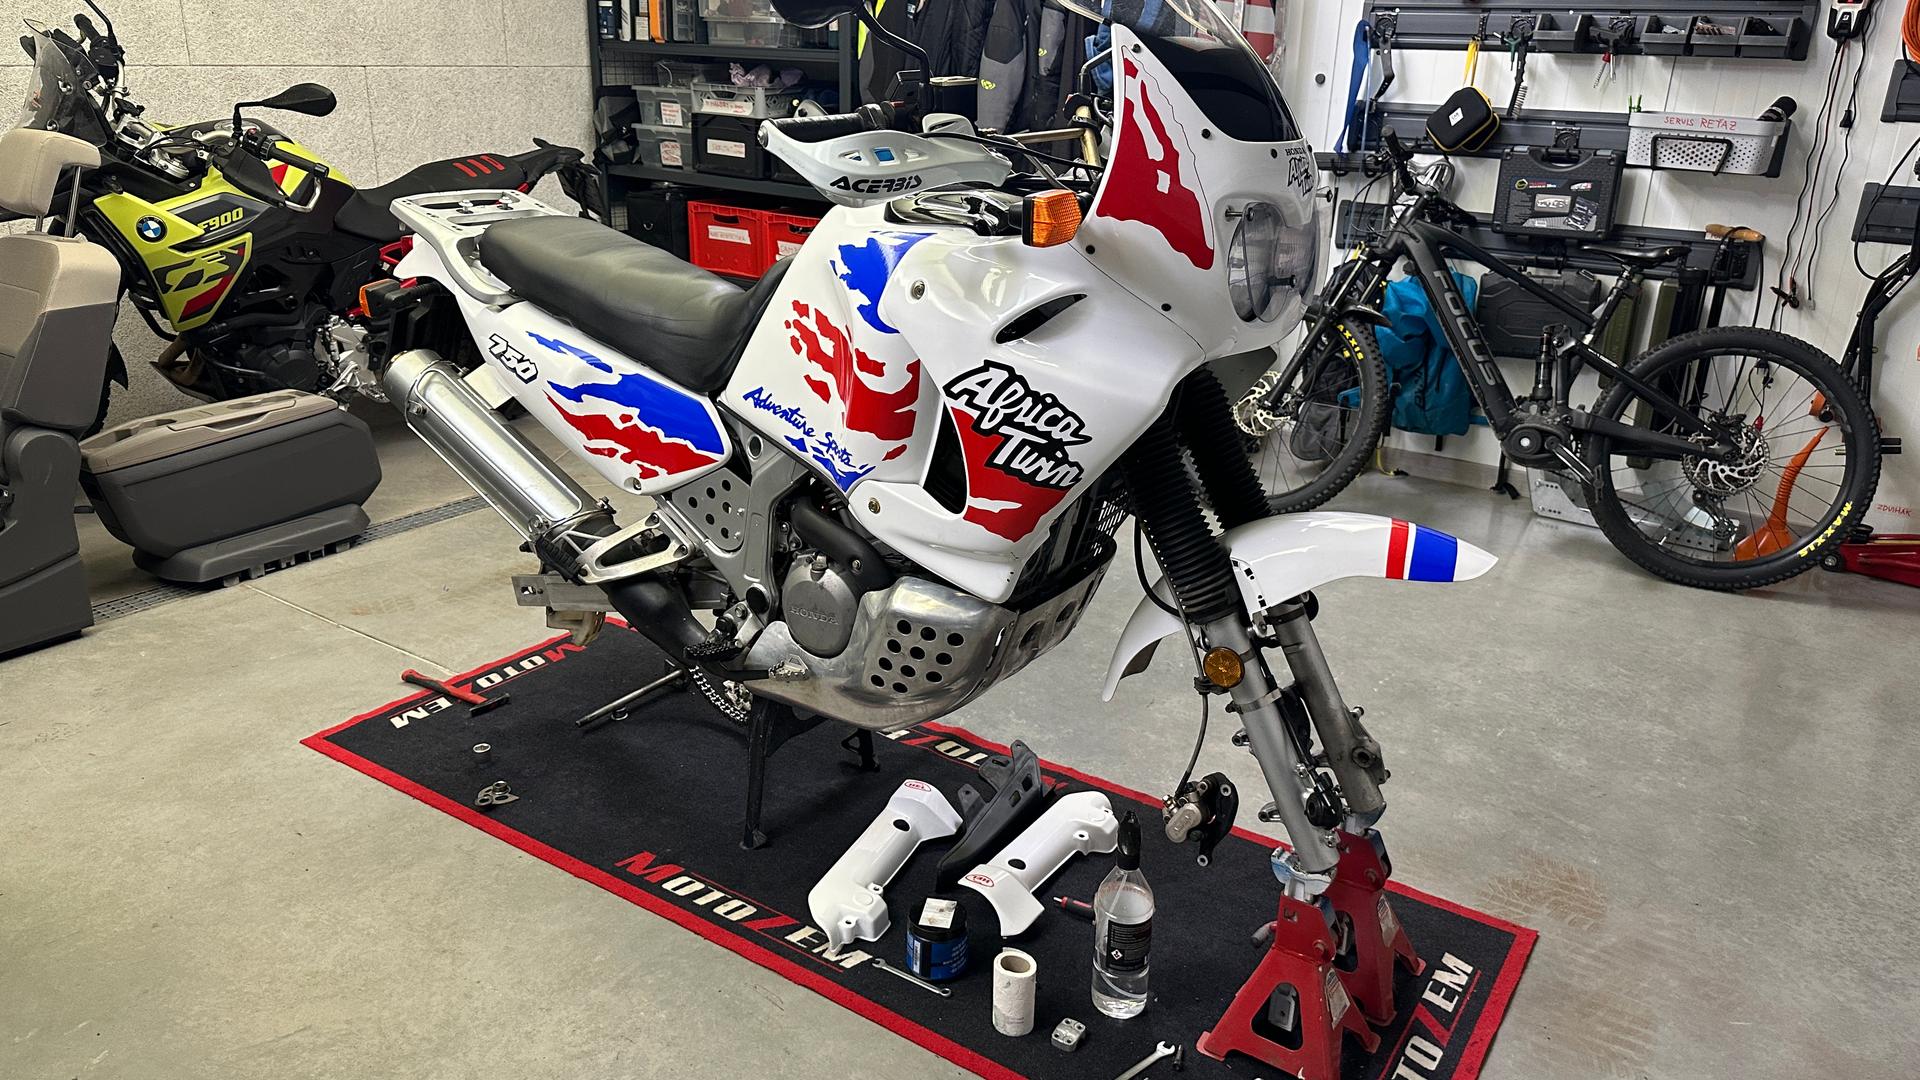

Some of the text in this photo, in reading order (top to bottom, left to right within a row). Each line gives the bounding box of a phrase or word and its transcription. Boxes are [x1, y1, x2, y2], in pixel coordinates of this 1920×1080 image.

[1664, 116, 1694, 126] SERVIS
[830, 174, 922, 194] ACERBIS
[1336, 324, 1364, 360] AXXIS
[1433, 270, 1503, 387] FOCUS
[489, 333, 538, 384] 750
[743, 386, 856, 468] Adventure Sports
[944, 360, 1092, 446] Africa
[986, 424, 1083, 490] Twin
[1799, 501, 1853, 557] MAXXIS
[790, 606, 840, 625] HONDA
